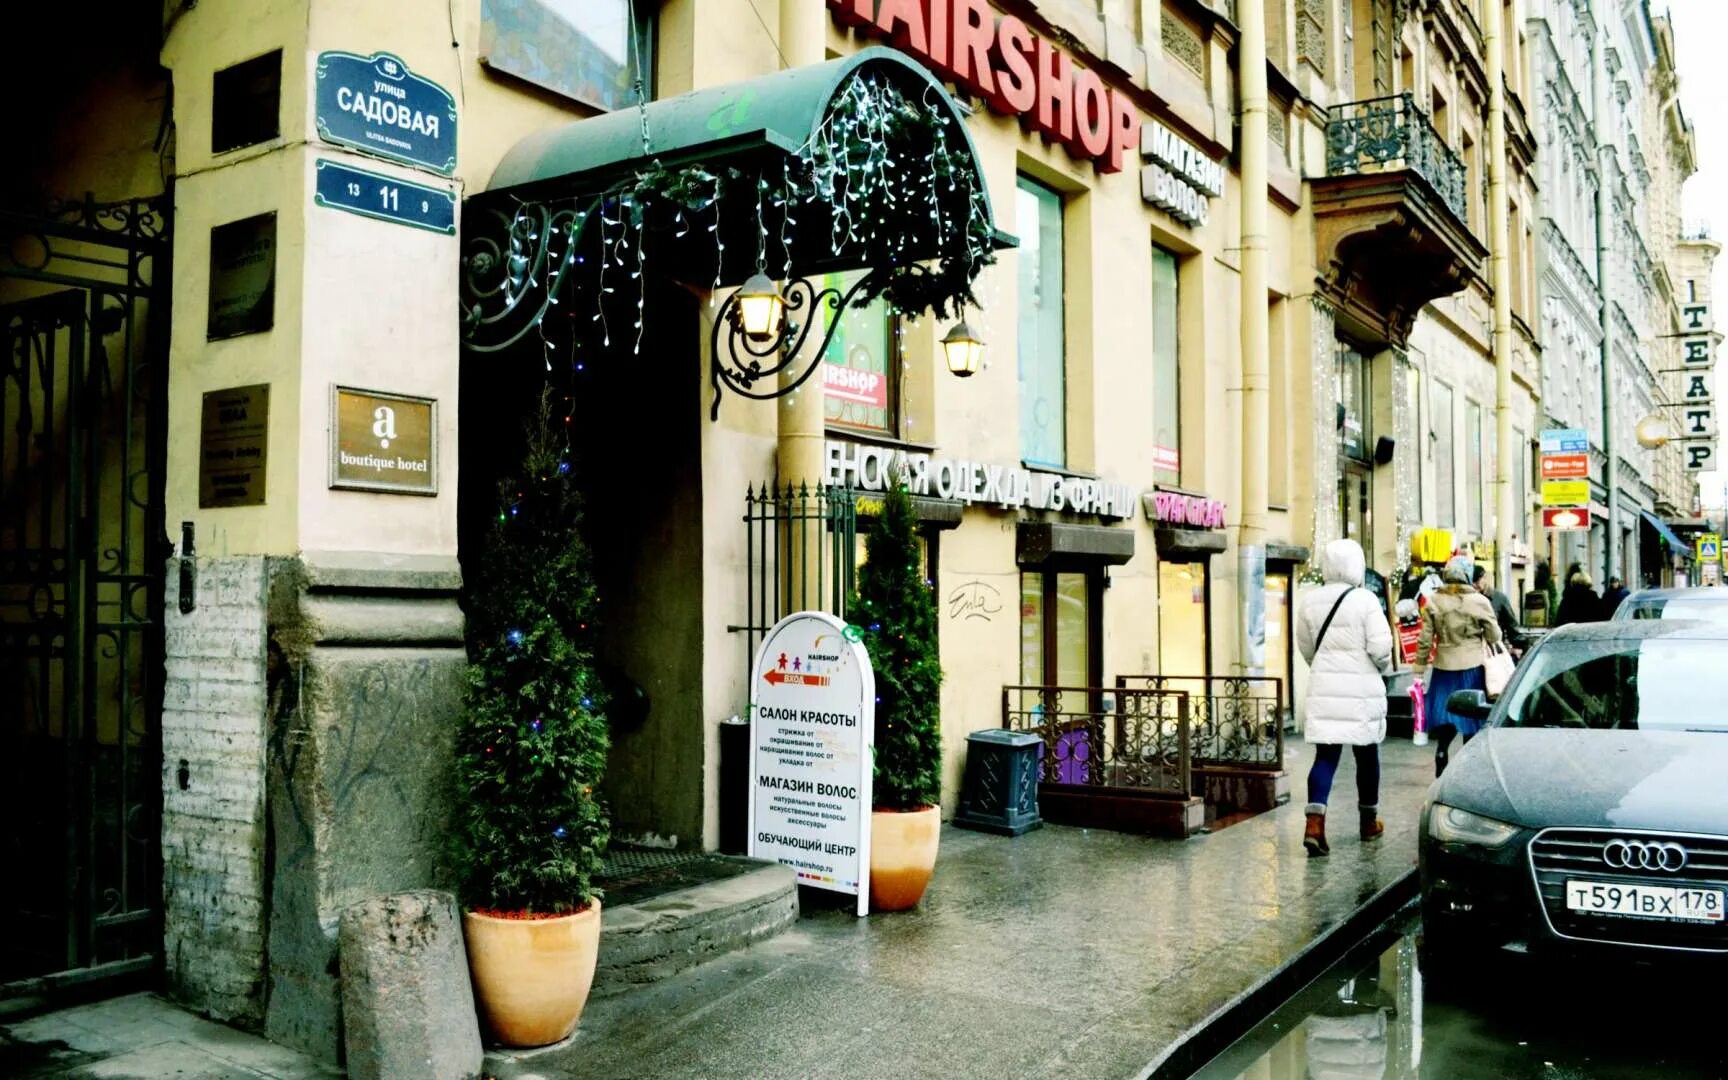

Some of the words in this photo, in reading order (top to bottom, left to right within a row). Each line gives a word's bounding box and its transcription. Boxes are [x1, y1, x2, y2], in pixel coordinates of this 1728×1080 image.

[374, 80, 406, 99] улица
[830, 0, 1142, 172] AIRSHOP
[337, 87, 439, 139] САДОВАЯ
[1150, 119, 1225, 198] МАГАЗИН
[348, 182, 360, 197] 13
[379, 186, 399, 212] 11
[422, 200, 429, 214] 9
[1684, 306, 1711, 469] ТЕАТР
[340, 451, 395, 472] boutique
[398, 457, 427, 472] hotel
[938, 458, 1032, 510] ОДЕЖДА
[1040, 473, 1064, 511] ИЗ
[808, 654, 839, 662] HAIRSHOP
[760, 706, 797, 722] САЛОН
[800, 710, 856, 727] КРАСОТЫ
[778, 728, 805, 736] стрижка
[760, 746, 804, 756] наращивание
[770, 737, 814, 748] окрашивание
[760, 775, 813, 794] МАГАЗИН
[817, 783, 856, 800] ВОЛОС
[770, 804, 820, 818] искусственные
[821, 812, 846, 822] волосы
[774, 796, 816, 806] натуральные
[818, 802, 842, 811] волосы
[787, 818, 826, 829] аксессуары
[758, 832, 822, 852] ОБУЧАЮЩИЙ
[825, 843, 856, 856] ЦЕНТР
[778, 858, 833, 873] www.hairshop.ru
[1679, 891, 1717, 910] 178
